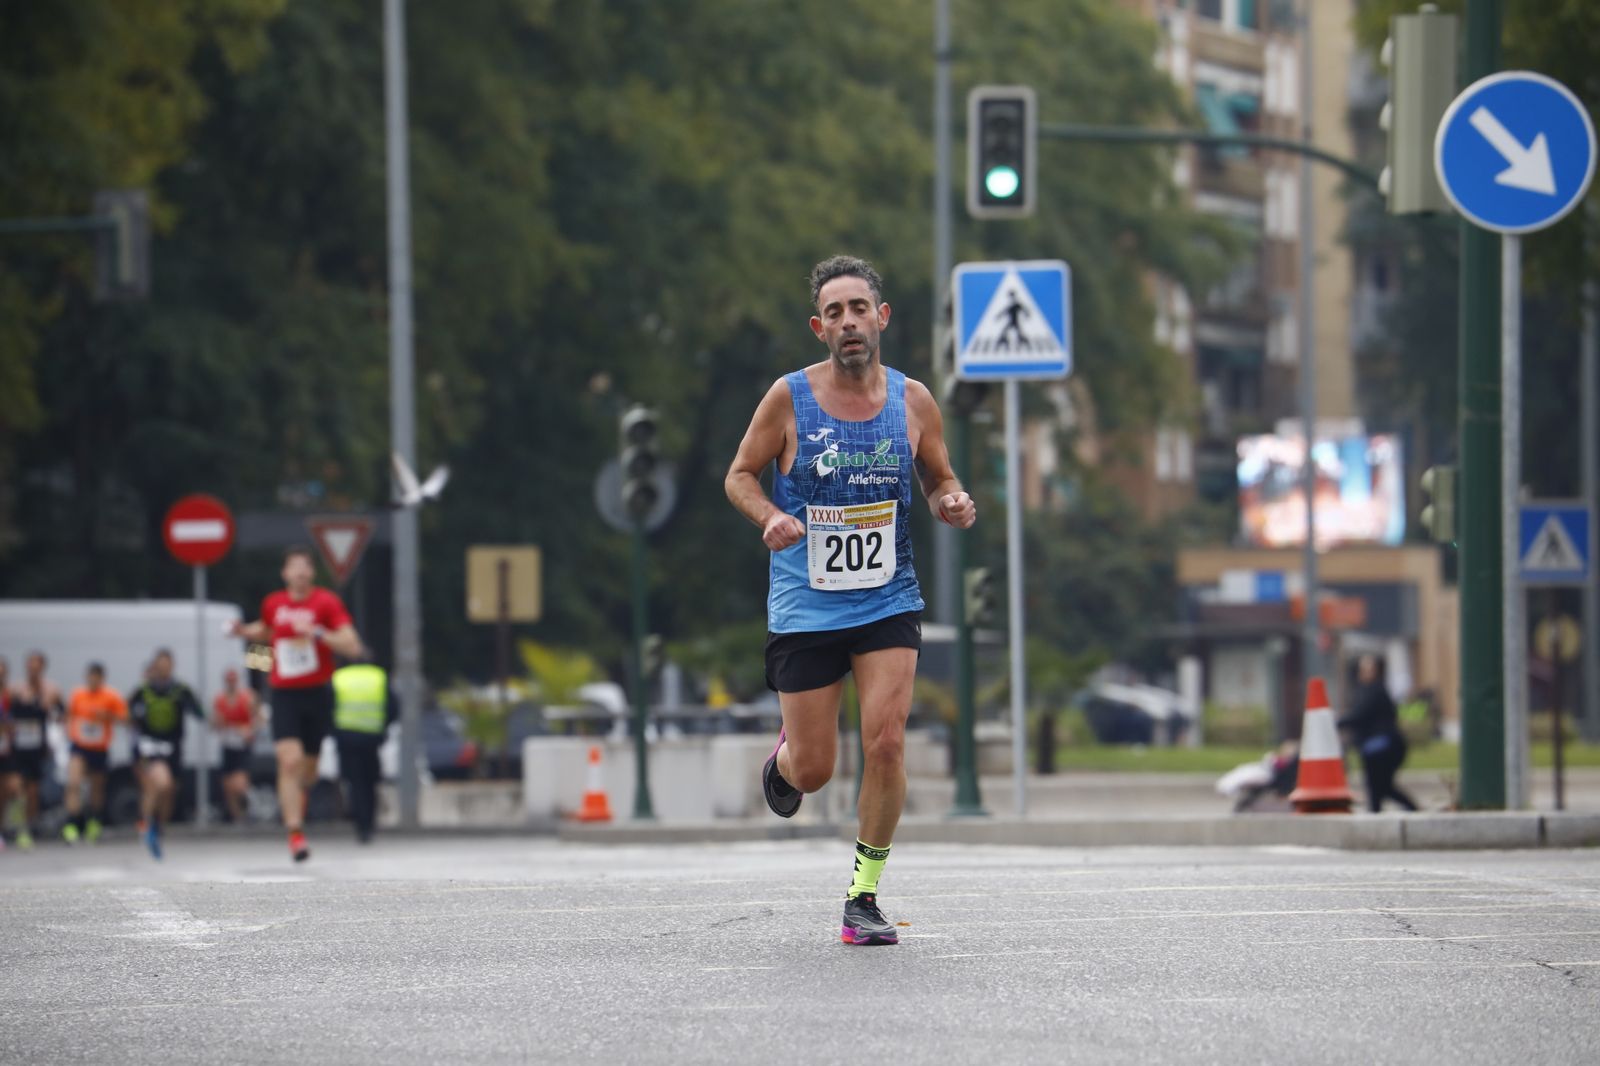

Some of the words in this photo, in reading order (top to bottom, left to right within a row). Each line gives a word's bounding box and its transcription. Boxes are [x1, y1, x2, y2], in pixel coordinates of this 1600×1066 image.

[847, 473, 899, 485] Atletismo
[810, 508, 845, 523] XXXIX
[825, 531, 883, 573] 202
